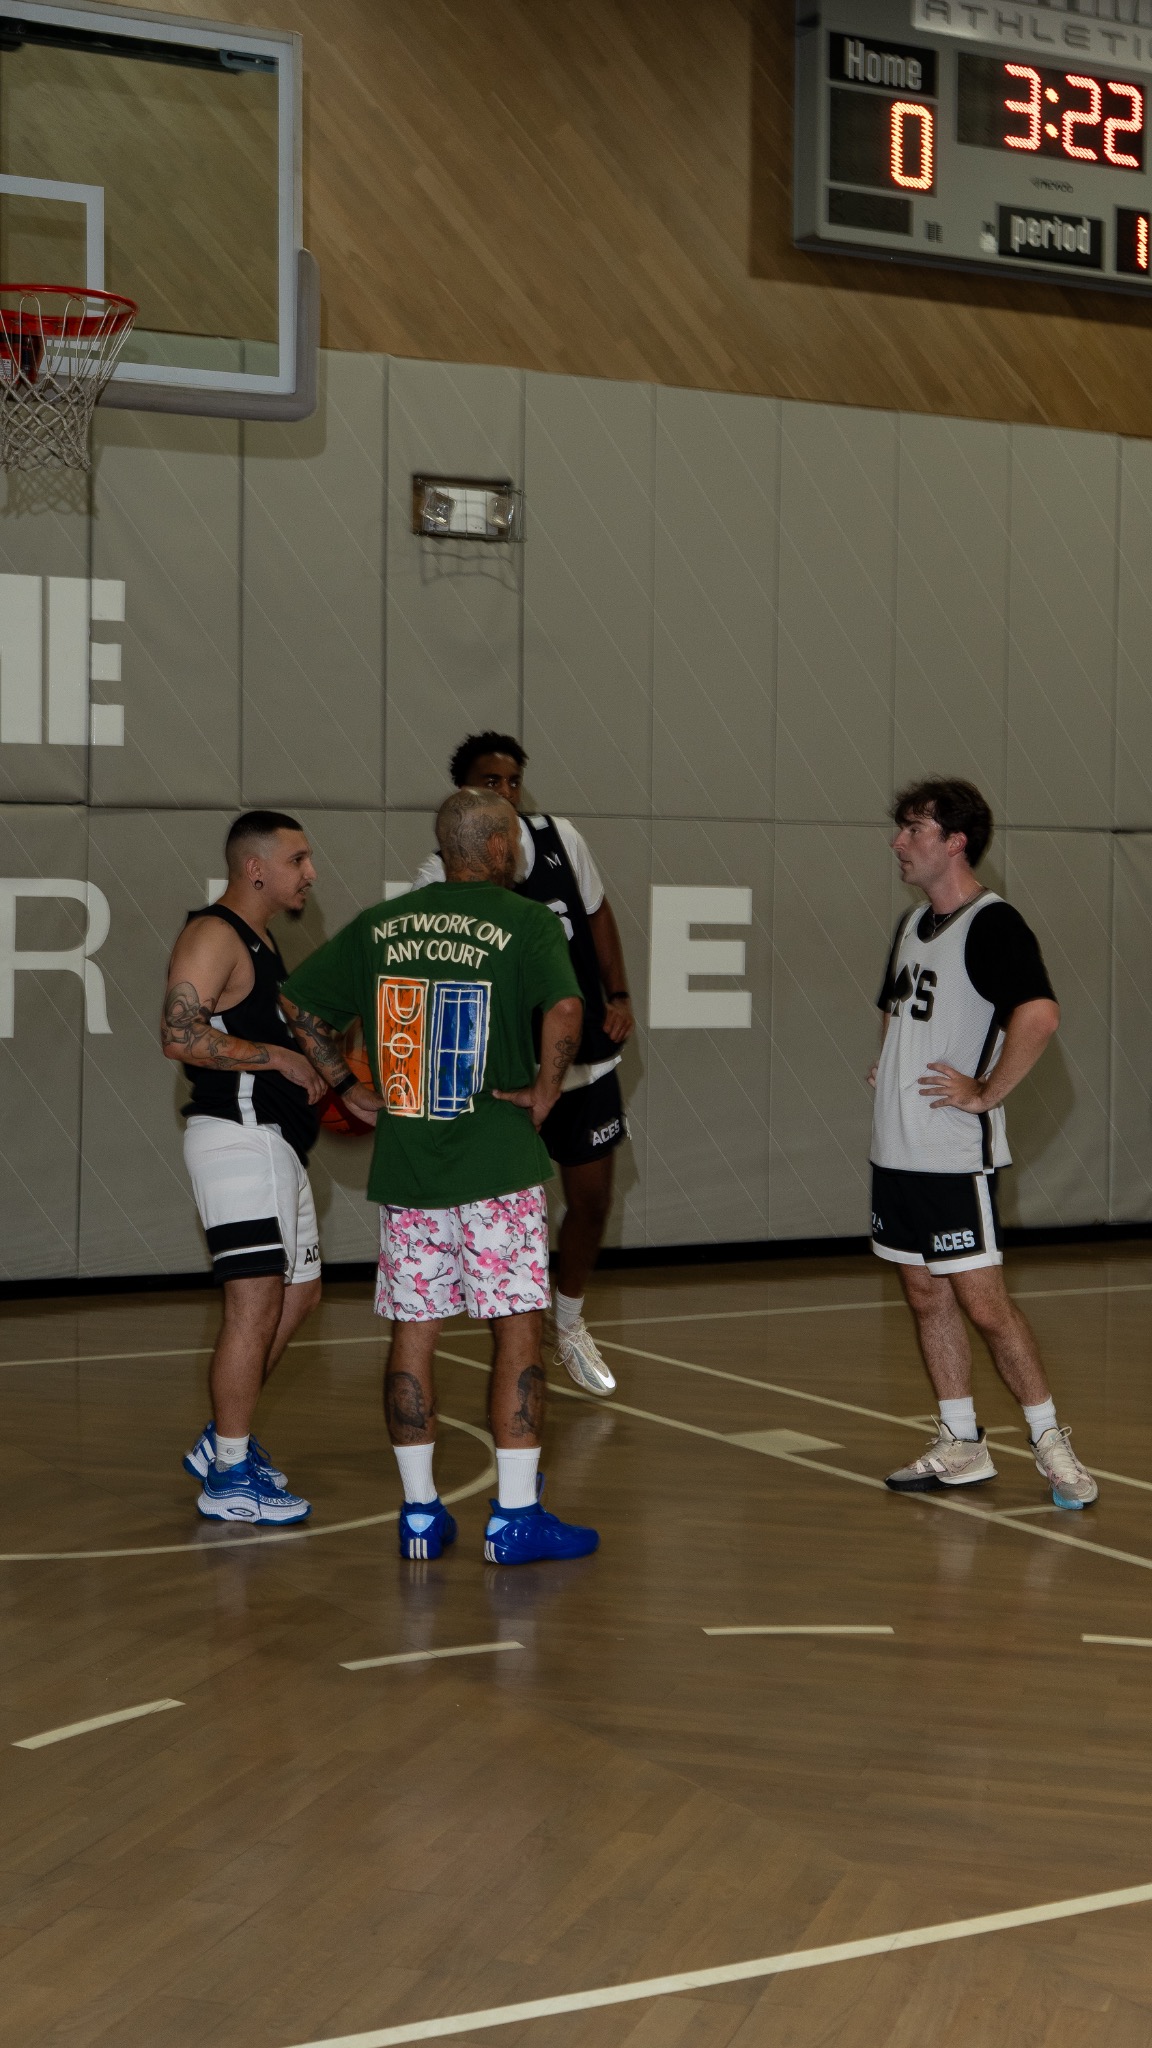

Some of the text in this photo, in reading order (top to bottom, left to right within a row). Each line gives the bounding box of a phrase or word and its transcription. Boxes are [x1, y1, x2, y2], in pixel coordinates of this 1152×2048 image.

[924, 1, 1152, 62] ATHLETI
[845, 37, 922, 91] Home
[1004, 62, 1143, 168] 3:22
[890, 101, 933, 190] 0
[1010, 213, 1092, 255] period
[1136, 215, 1149, 269] 1
[373, 914, 478, 943] NETWORK
[476, 921, 513, 951] ON
[386, 939, 489, 970] ANY COURT
[591, 1118, 622, 1147] ACES
[934, 1229, 977, 1253] ACES
